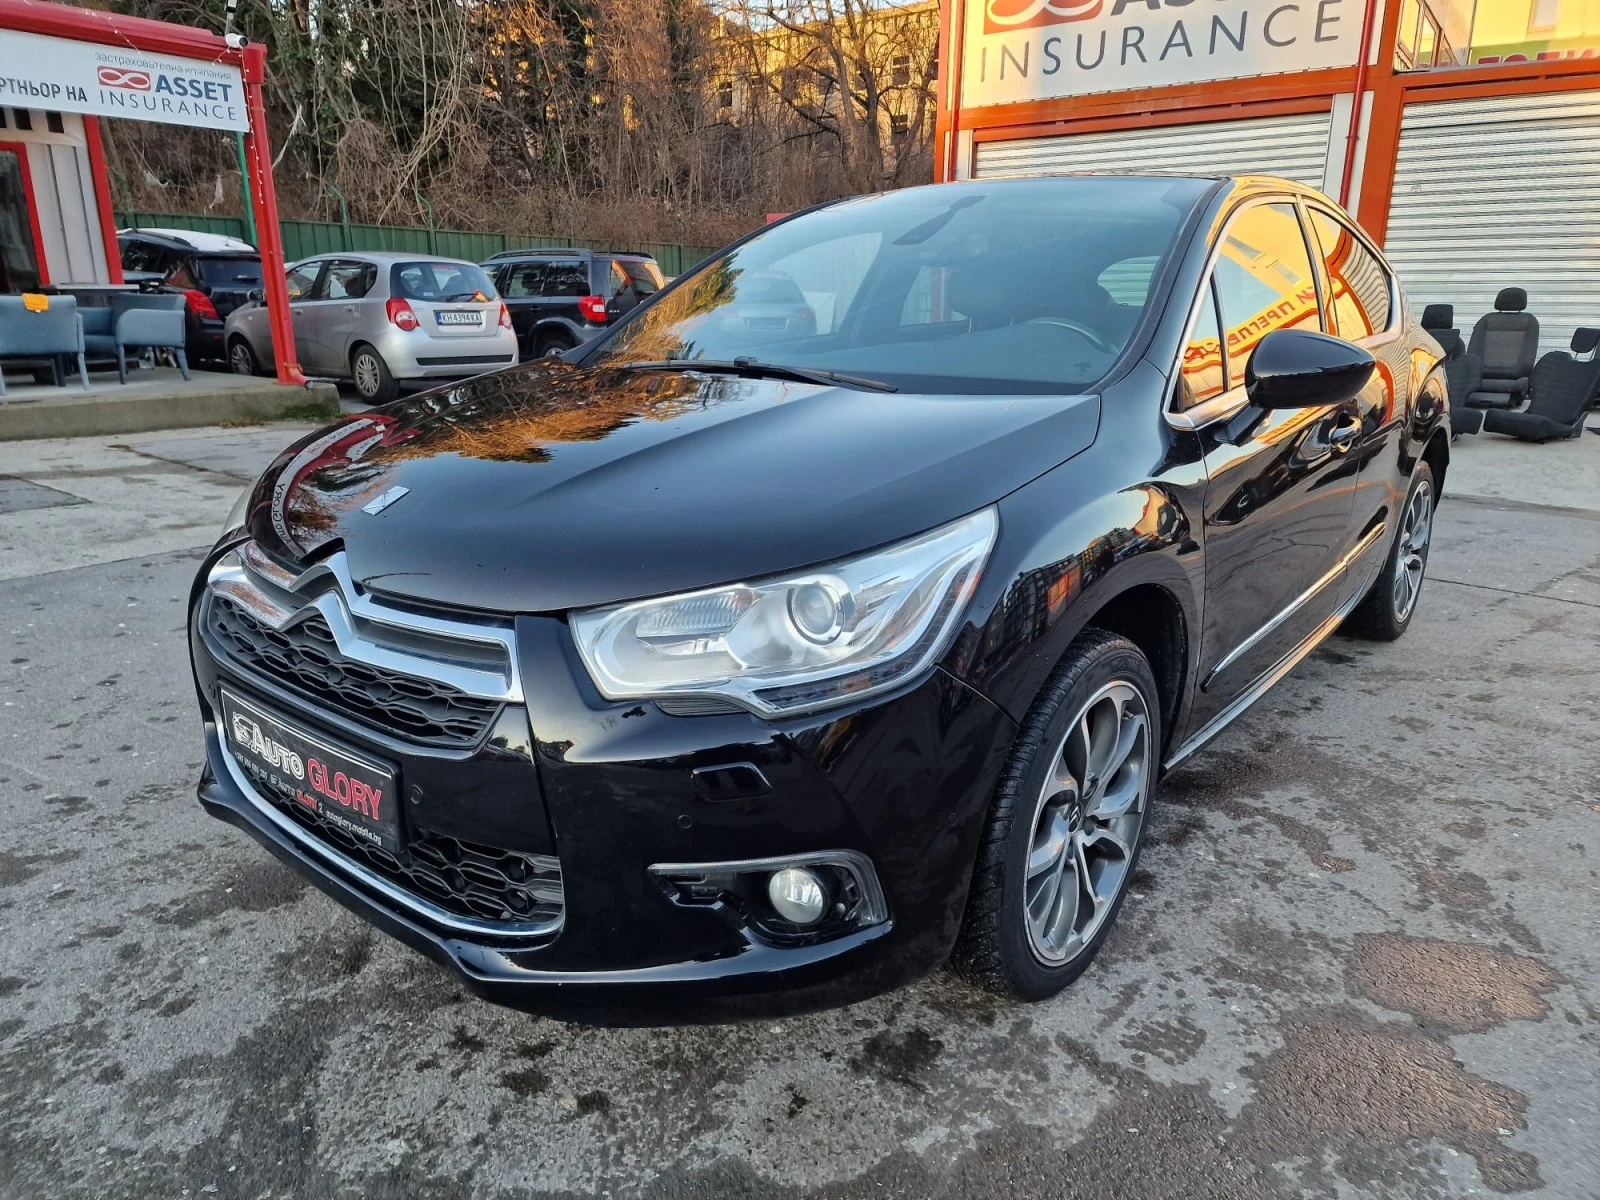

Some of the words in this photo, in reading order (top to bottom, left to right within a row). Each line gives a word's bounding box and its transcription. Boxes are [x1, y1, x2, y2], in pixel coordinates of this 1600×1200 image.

[980, 0, 1342, 83] INSURANCE
[65, 85, 88, 102] НА
[155, 74, 233, 103] ASSET
[99, 89, 237, 121] INSURANCE
[250, 722, 305, 780] AUTO
[307, 758, 382, 821] GLORY
